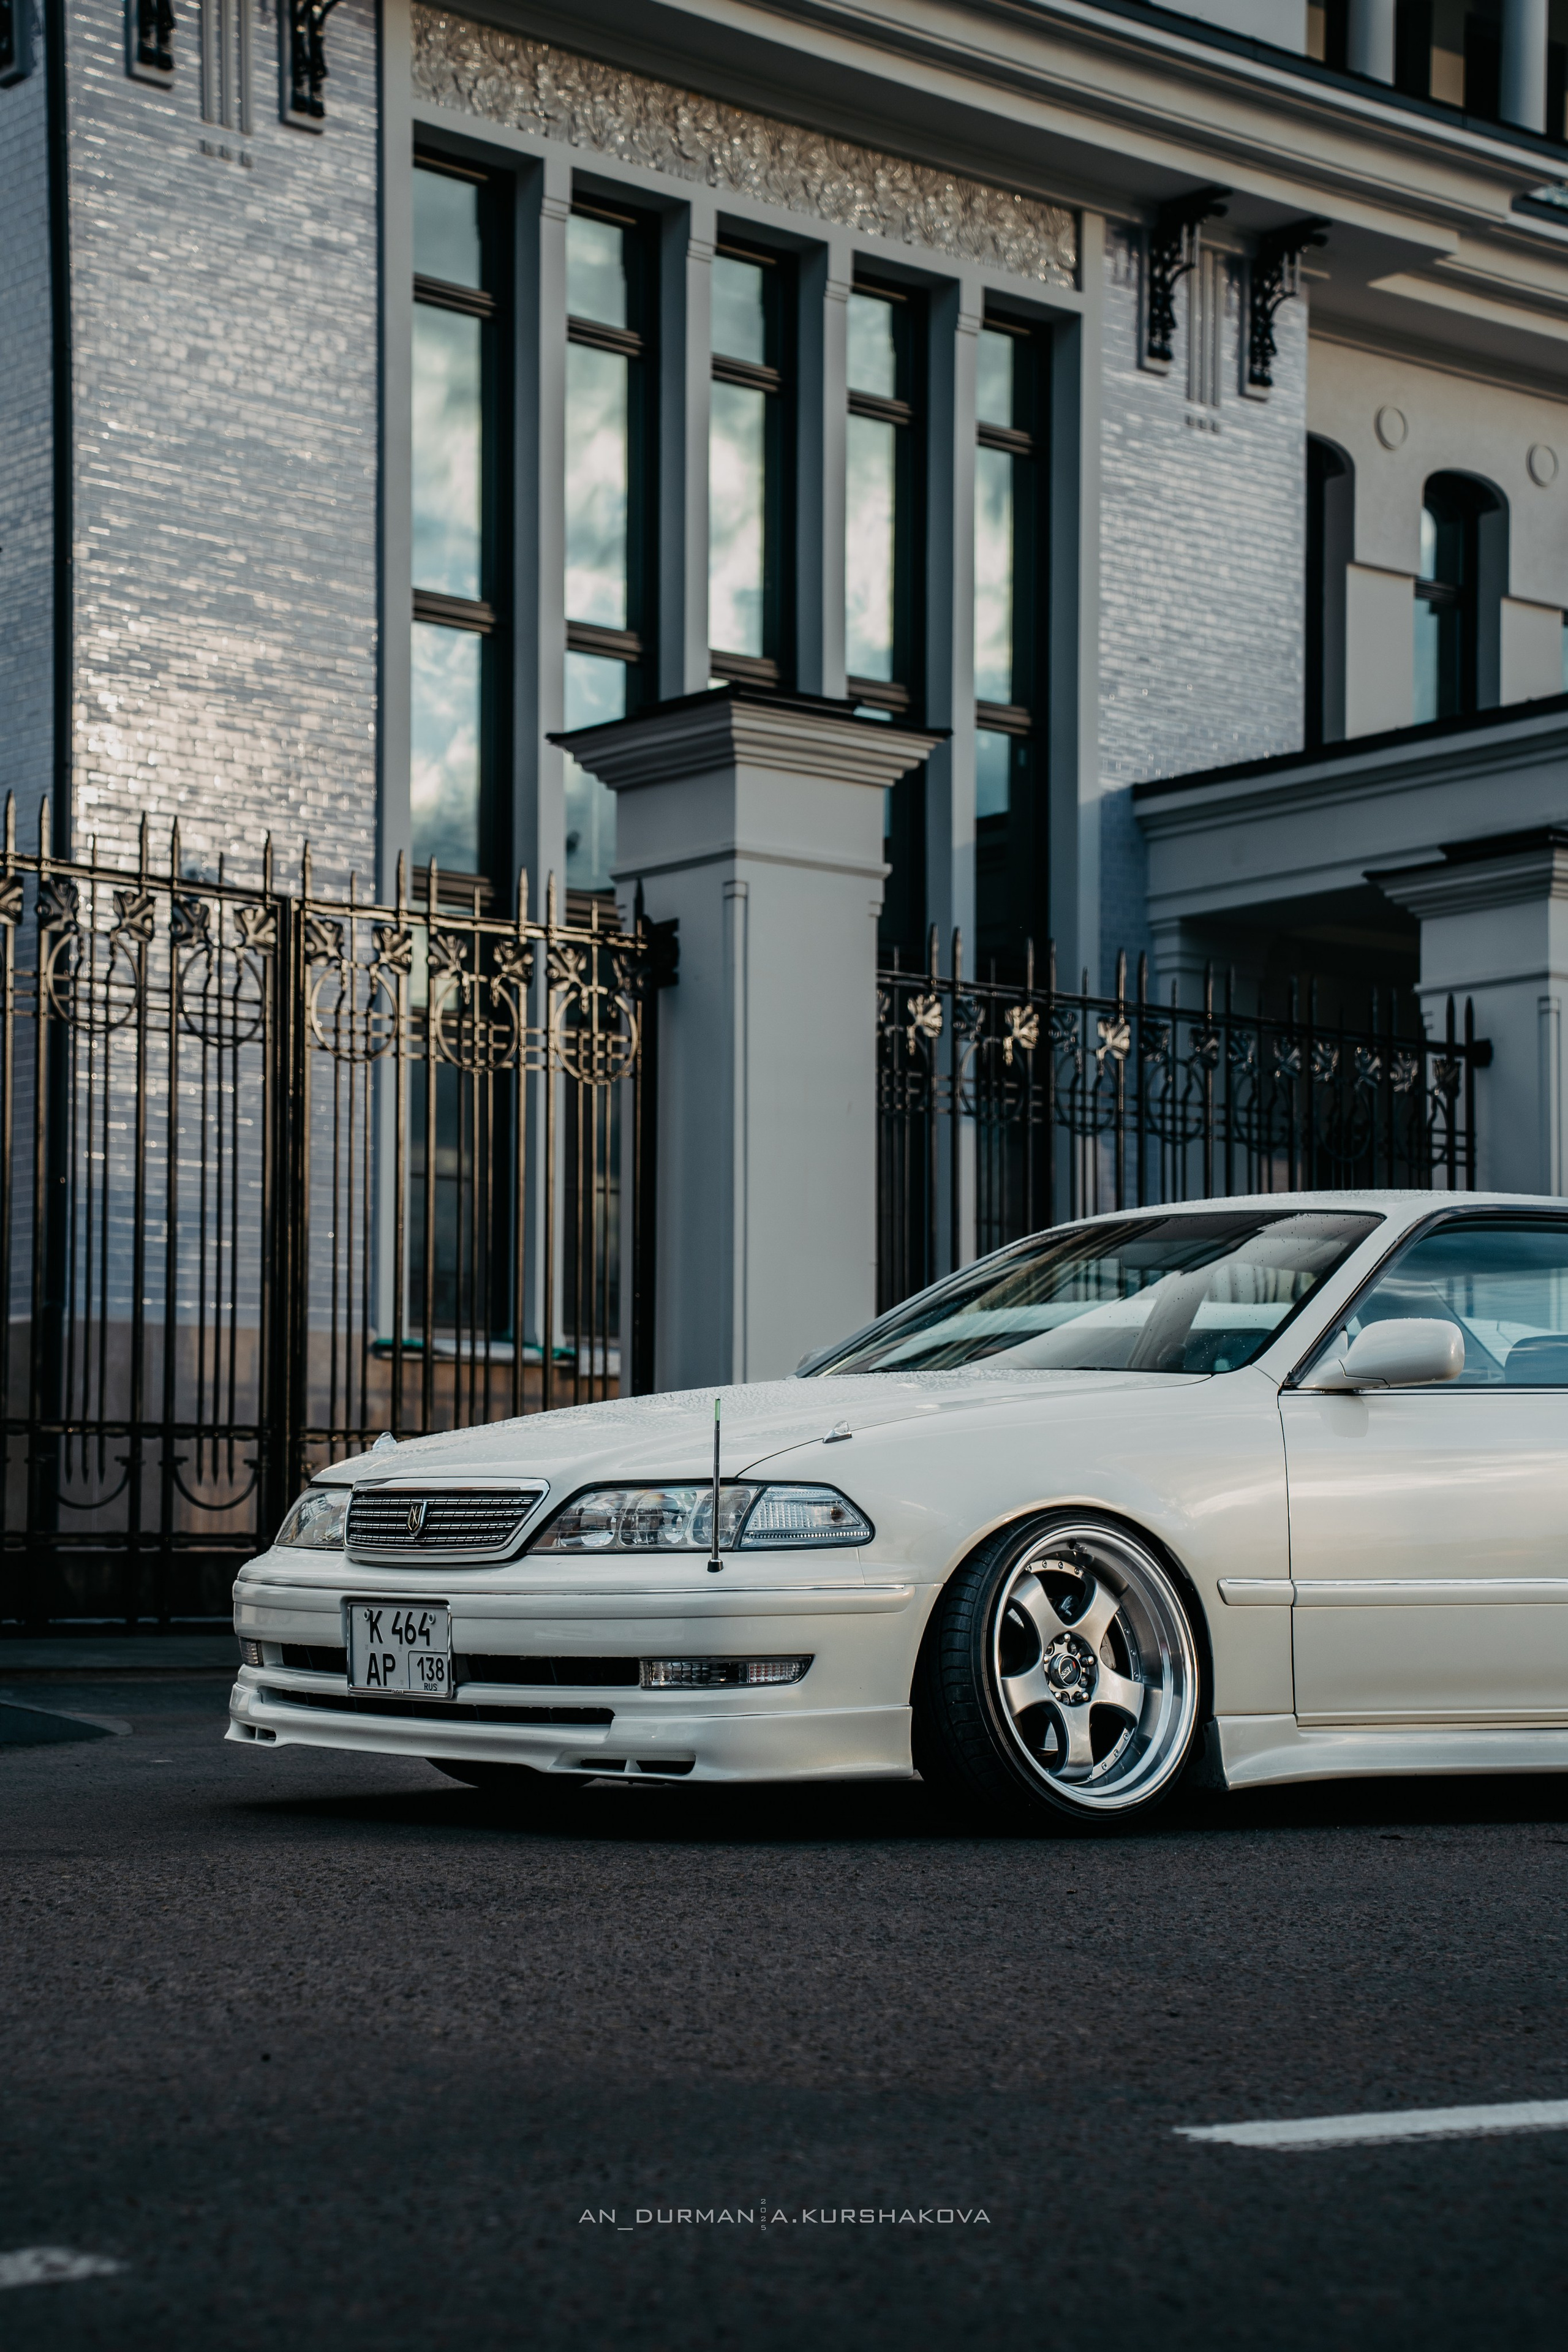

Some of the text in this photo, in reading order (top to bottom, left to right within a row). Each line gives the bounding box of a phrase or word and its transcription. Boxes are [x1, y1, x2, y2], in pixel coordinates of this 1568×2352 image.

[369, 1610, 430, 1646] K 464
[366, 1653, 444, 1686] AP 138
